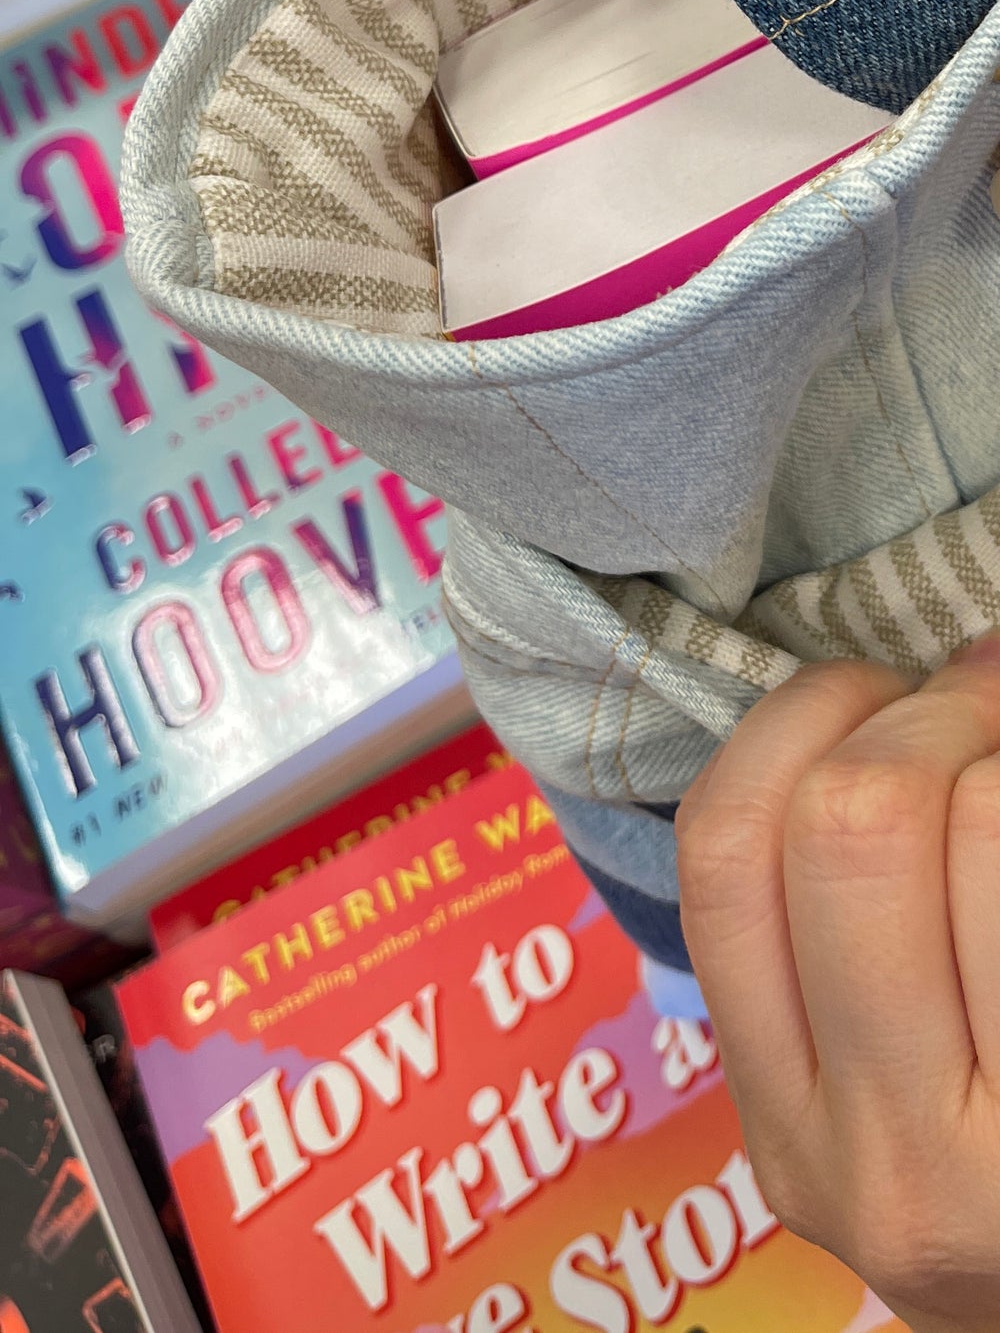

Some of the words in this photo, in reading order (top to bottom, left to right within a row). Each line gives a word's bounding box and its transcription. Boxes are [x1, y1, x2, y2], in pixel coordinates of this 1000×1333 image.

[34, 471, 446, 800] HOOVE
[113, 773, 169, 821] NEW
[182, 838, 466, 1025] CATHERINE
[474, 794, 557, 853] WA
[202, 982, 438, 1222] How
[469, 922, 576, 1032] to
[248, 963, 359, 1033] Bestselling
[357, 924, 421, 973] author
[423, 903, 448, 936] of
[448, 868, 524, 920] Holiday
[314, 1044, 626, 1314] Write
